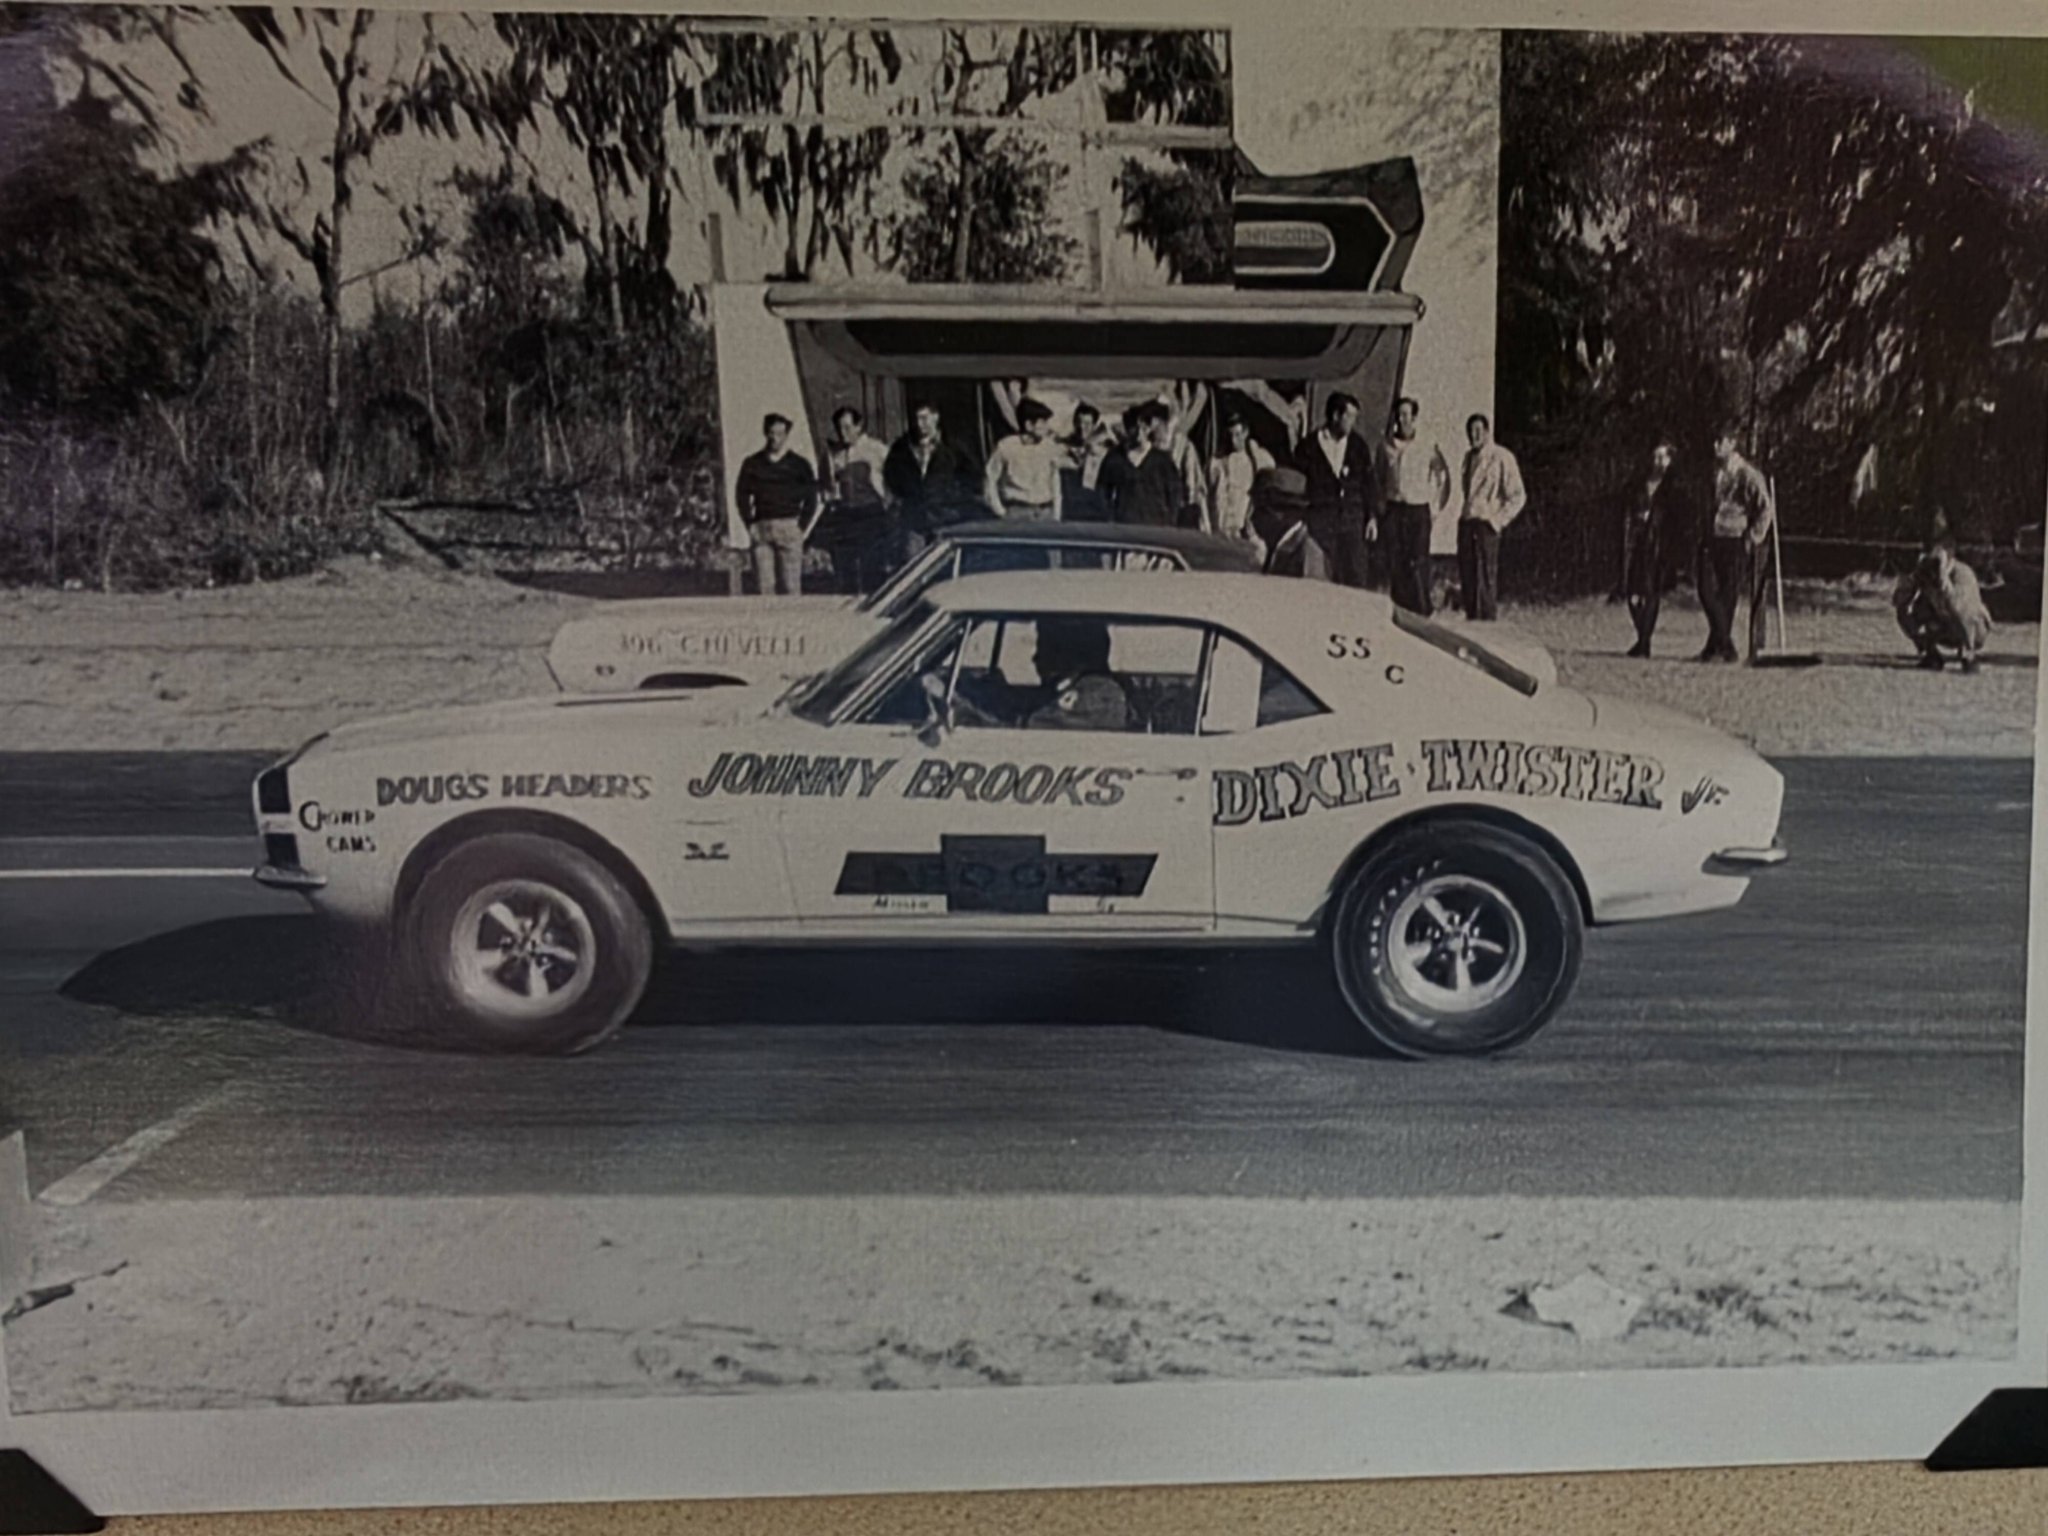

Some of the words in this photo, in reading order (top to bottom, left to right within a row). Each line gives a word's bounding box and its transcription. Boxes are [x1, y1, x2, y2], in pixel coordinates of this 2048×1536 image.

[1327, 634, 1371, 659] SS
[1385, 663, 1405, 685] C
[501, 774, 652, 799] HEADERS
[687, 752, 898, 799] JOHNNY
[1212, 742, 1401, 826] DIXIE
[1420, 738, 1665, 811] TWISTER
[325, 835, 377, 853] CAMS
